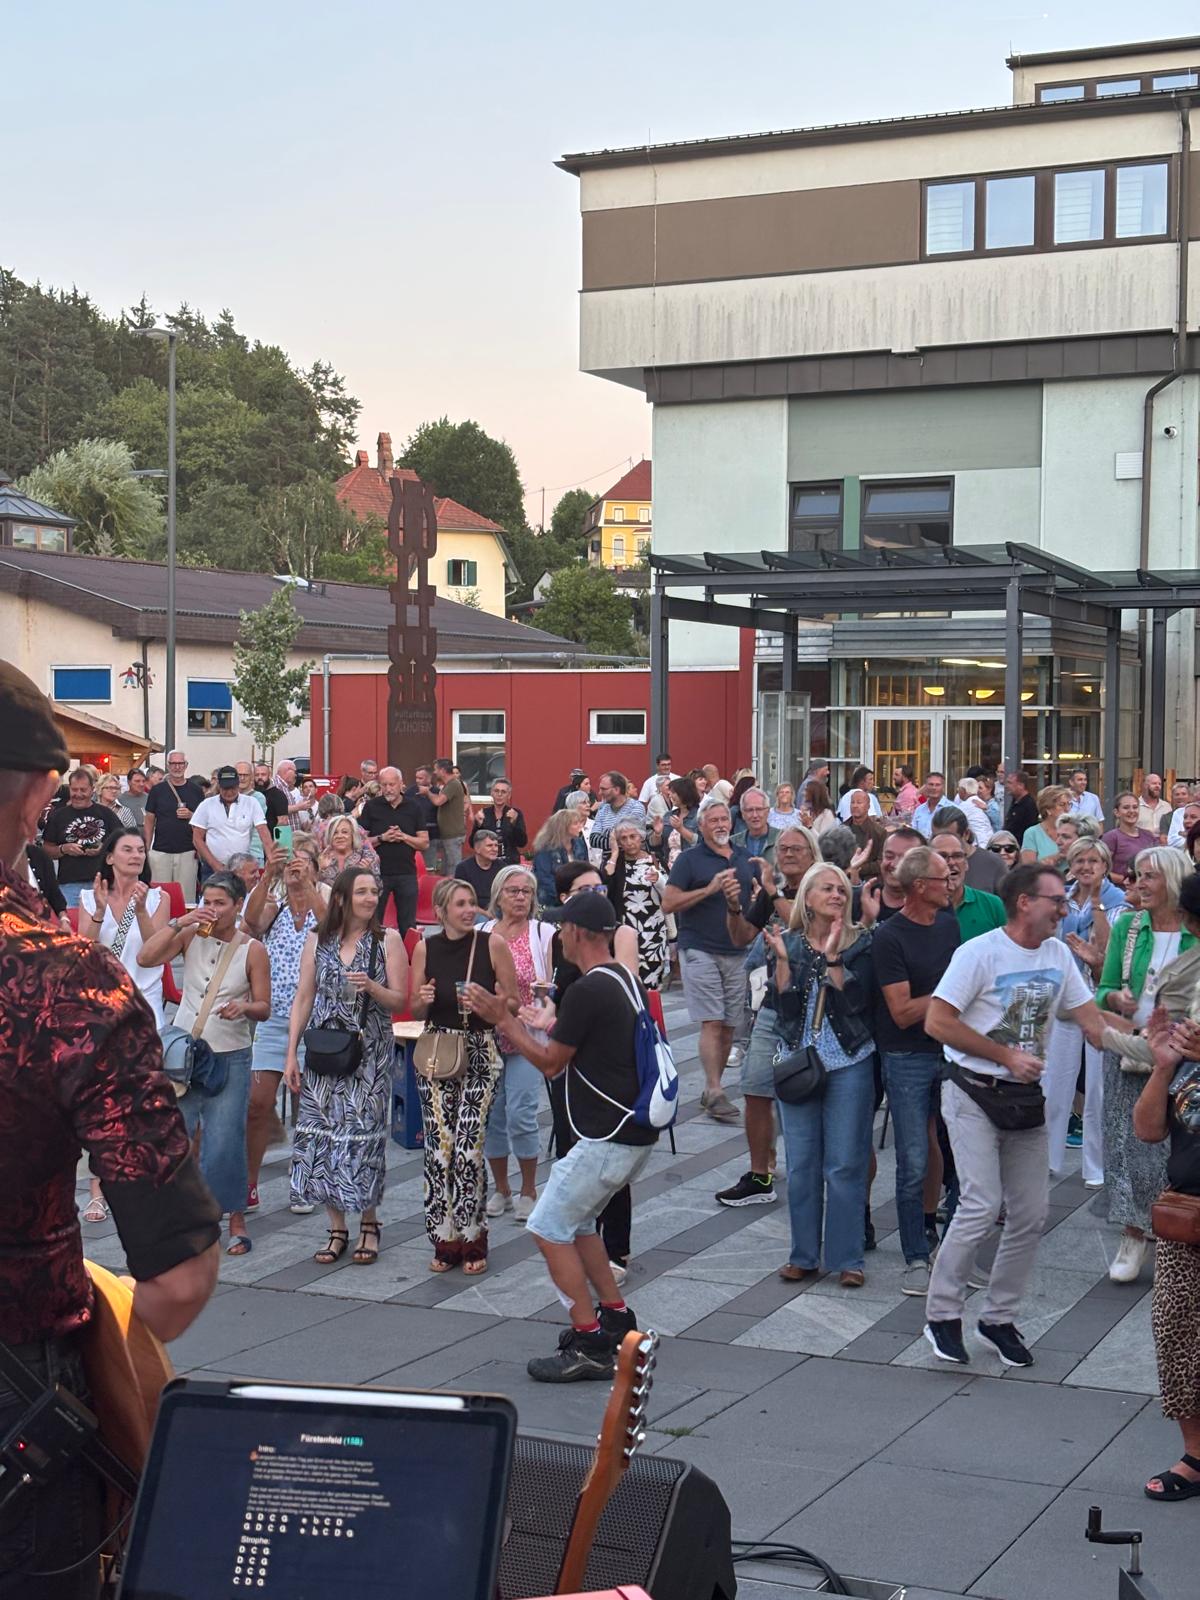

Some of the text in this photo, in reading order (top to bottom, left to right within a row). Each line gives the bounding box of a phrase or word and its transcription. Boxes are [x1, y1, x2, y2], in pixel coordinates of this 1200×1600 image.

[301, 1434, 342, 1445] Fürstenfeld
[246, 1512, 252, 1520] G
[258, 1512, 264, 1521] D
[269, 1513, 275, 1521] C
[281, 1514, 288, 1522] G
[313, 1515, 319, 1524] b
[324, 1517, 330, 1525] C
[336, 1518, 342, 1526] D
[244, 1522, 250, 1530] G
[256, 1522, 262, 1531] D
[268, 1523, 274, 1532] C
[280, 1524, 286, 1532] G
[312, 1525, 318, 1535] b
[323, 1527, 328, 1535] C
[335, 1528, 341, 1536] D
[347, 1529, 353, 1537] G
[241, 1535, 271, 1545] Strophe:
[239, 1545, 269, 1555] D C G
[237, 1555, 267, 1565] D C G
[235, 1565, 266, 1576] D C G
[233, 1576, 264, 1586] C D G
